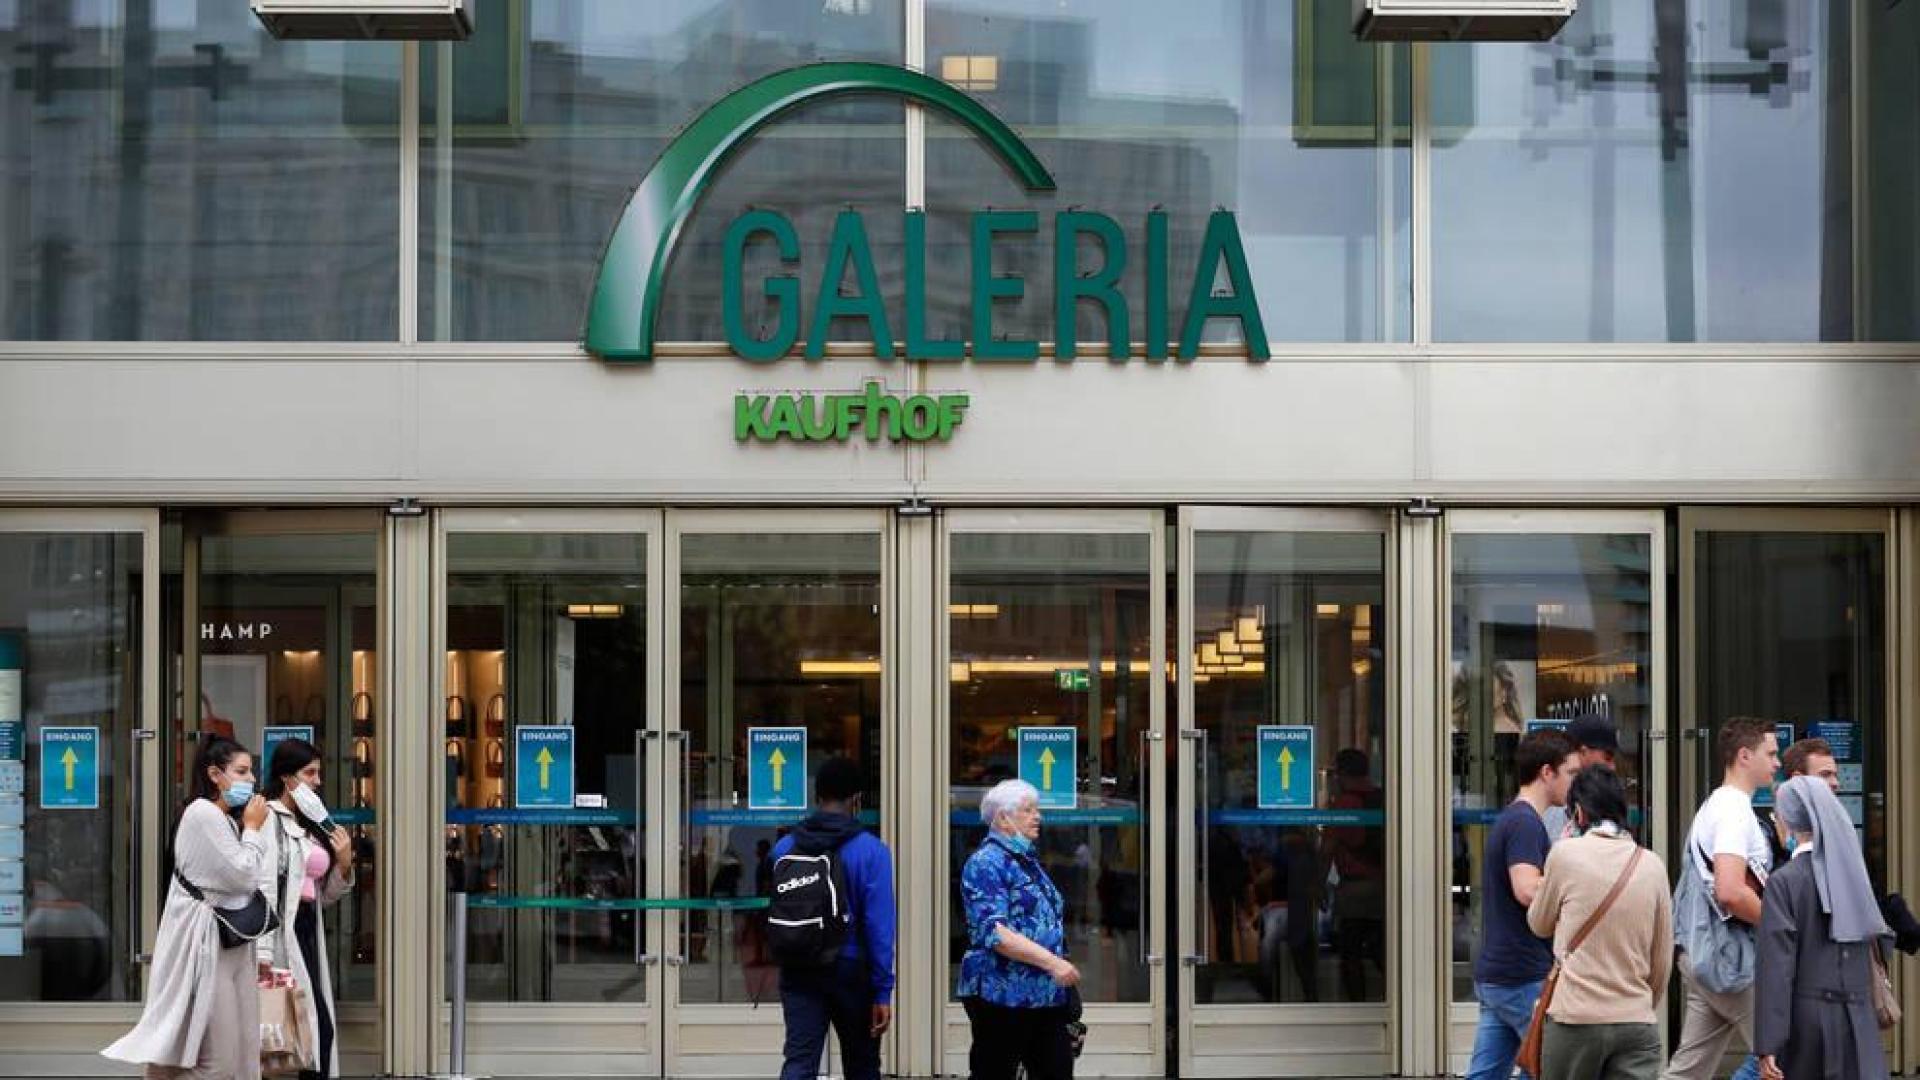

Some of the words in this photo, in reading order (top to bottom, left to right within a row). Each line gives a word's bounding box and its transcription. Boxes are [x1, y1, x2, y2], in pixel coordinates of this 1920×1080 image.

[722, 210, 1271, 362] GALERIA
[521, 732, 569, 742] EINGANG
[753, 732, 800, 742] EINGANG
[1023, 732, 1071, 742] EINGANG
[1263, 732, 1308, 741] EINGANG
[777, 872, 820, 893] adidas
